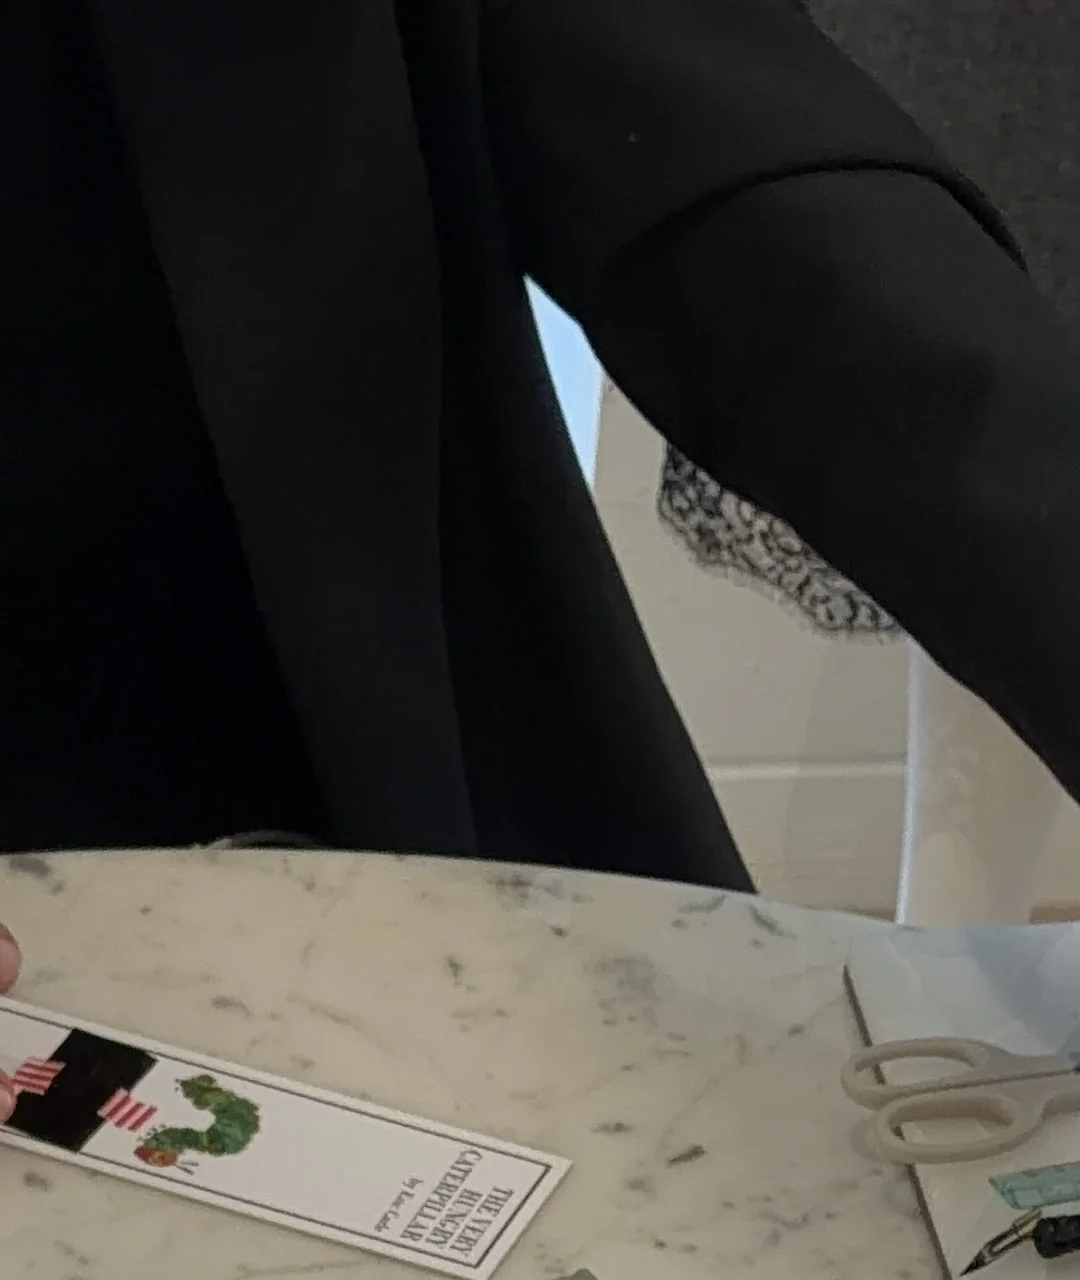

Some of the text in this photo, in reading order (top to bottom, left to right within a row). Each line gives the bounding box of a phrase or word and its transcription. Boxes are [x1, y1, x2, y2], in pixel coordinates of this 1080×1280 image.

[400, 1149, 483, 1241] CATERPILLAR
[425, 1188, 484, 1247] HUNGRY
[450, 1185, 515, 1257] THE VERY
